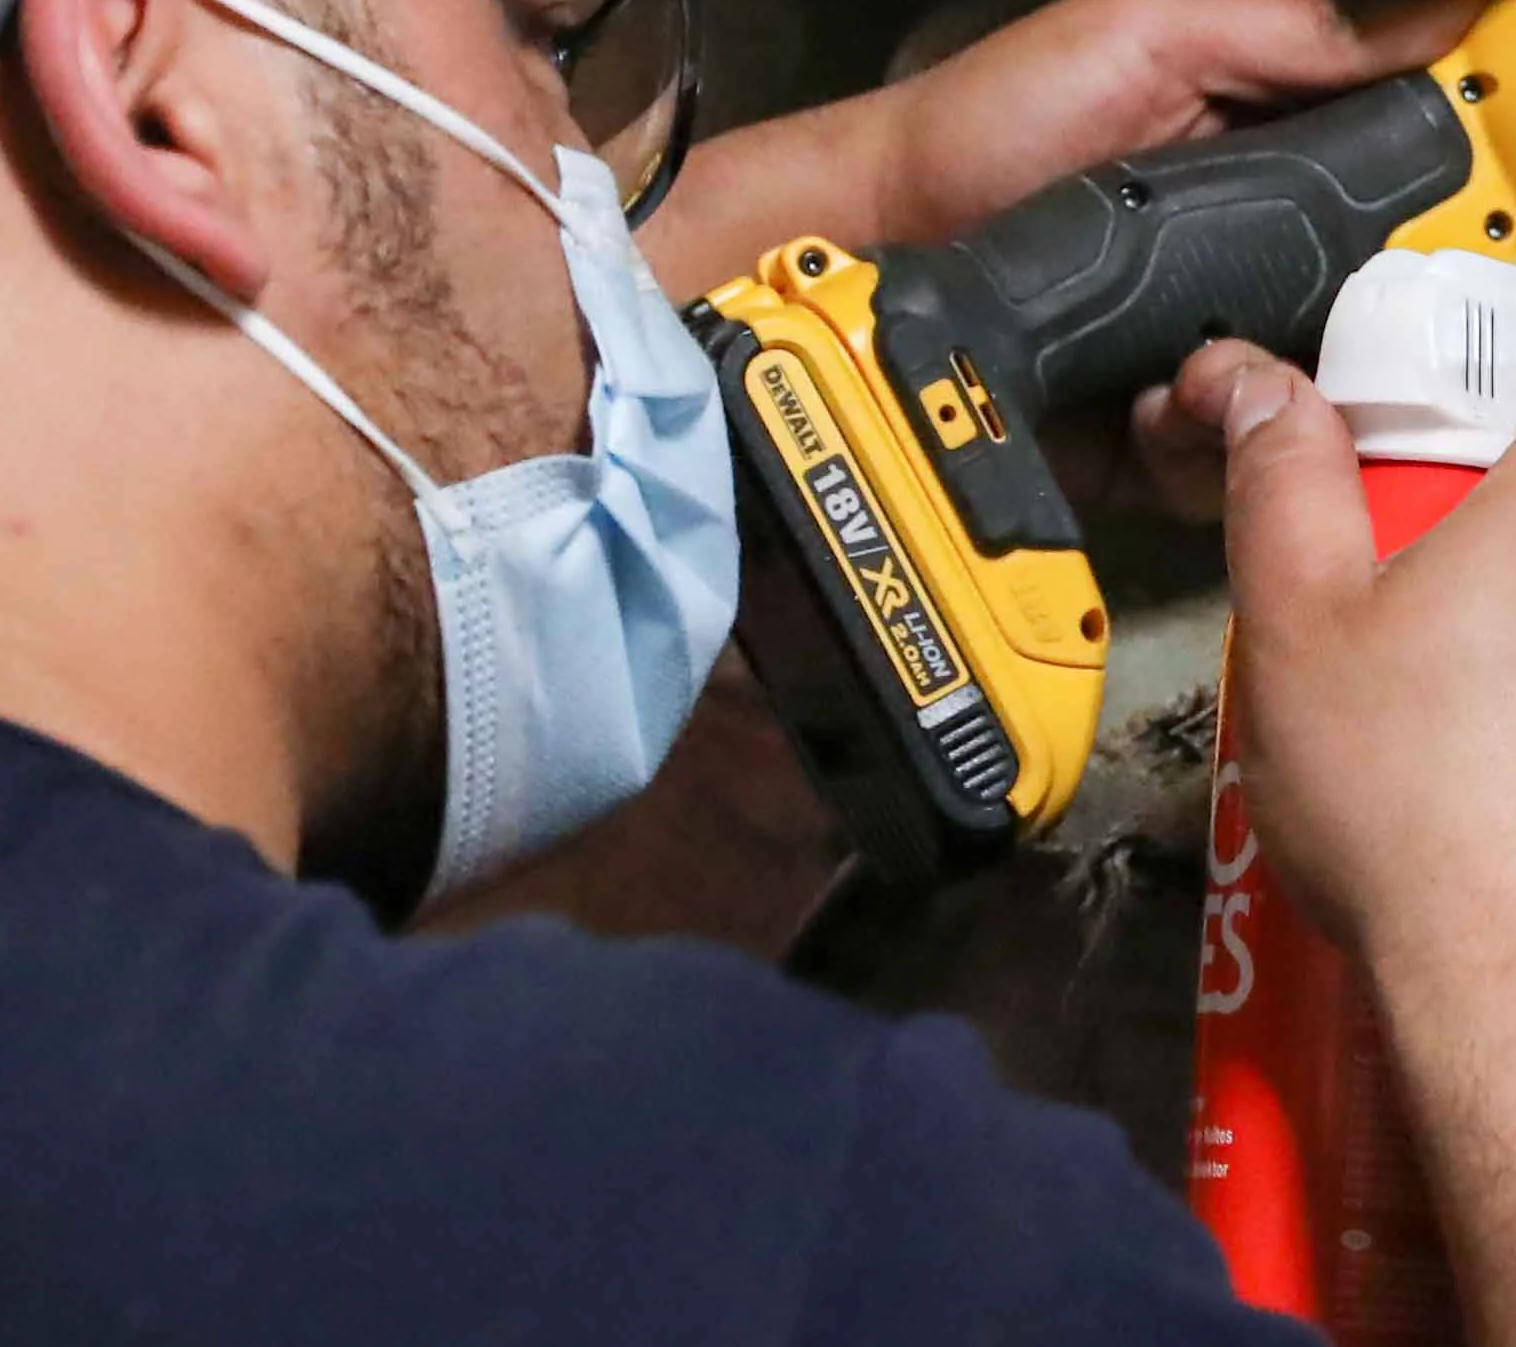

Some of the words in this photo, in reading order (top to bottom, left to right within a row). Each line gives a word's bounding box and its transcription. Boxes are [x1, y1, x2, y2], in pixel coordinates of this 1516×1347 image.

[812, 461, 879, 546] 18V
[859, 555, 910, 621] XR
[903, 610, 952, 680] LI-ION
